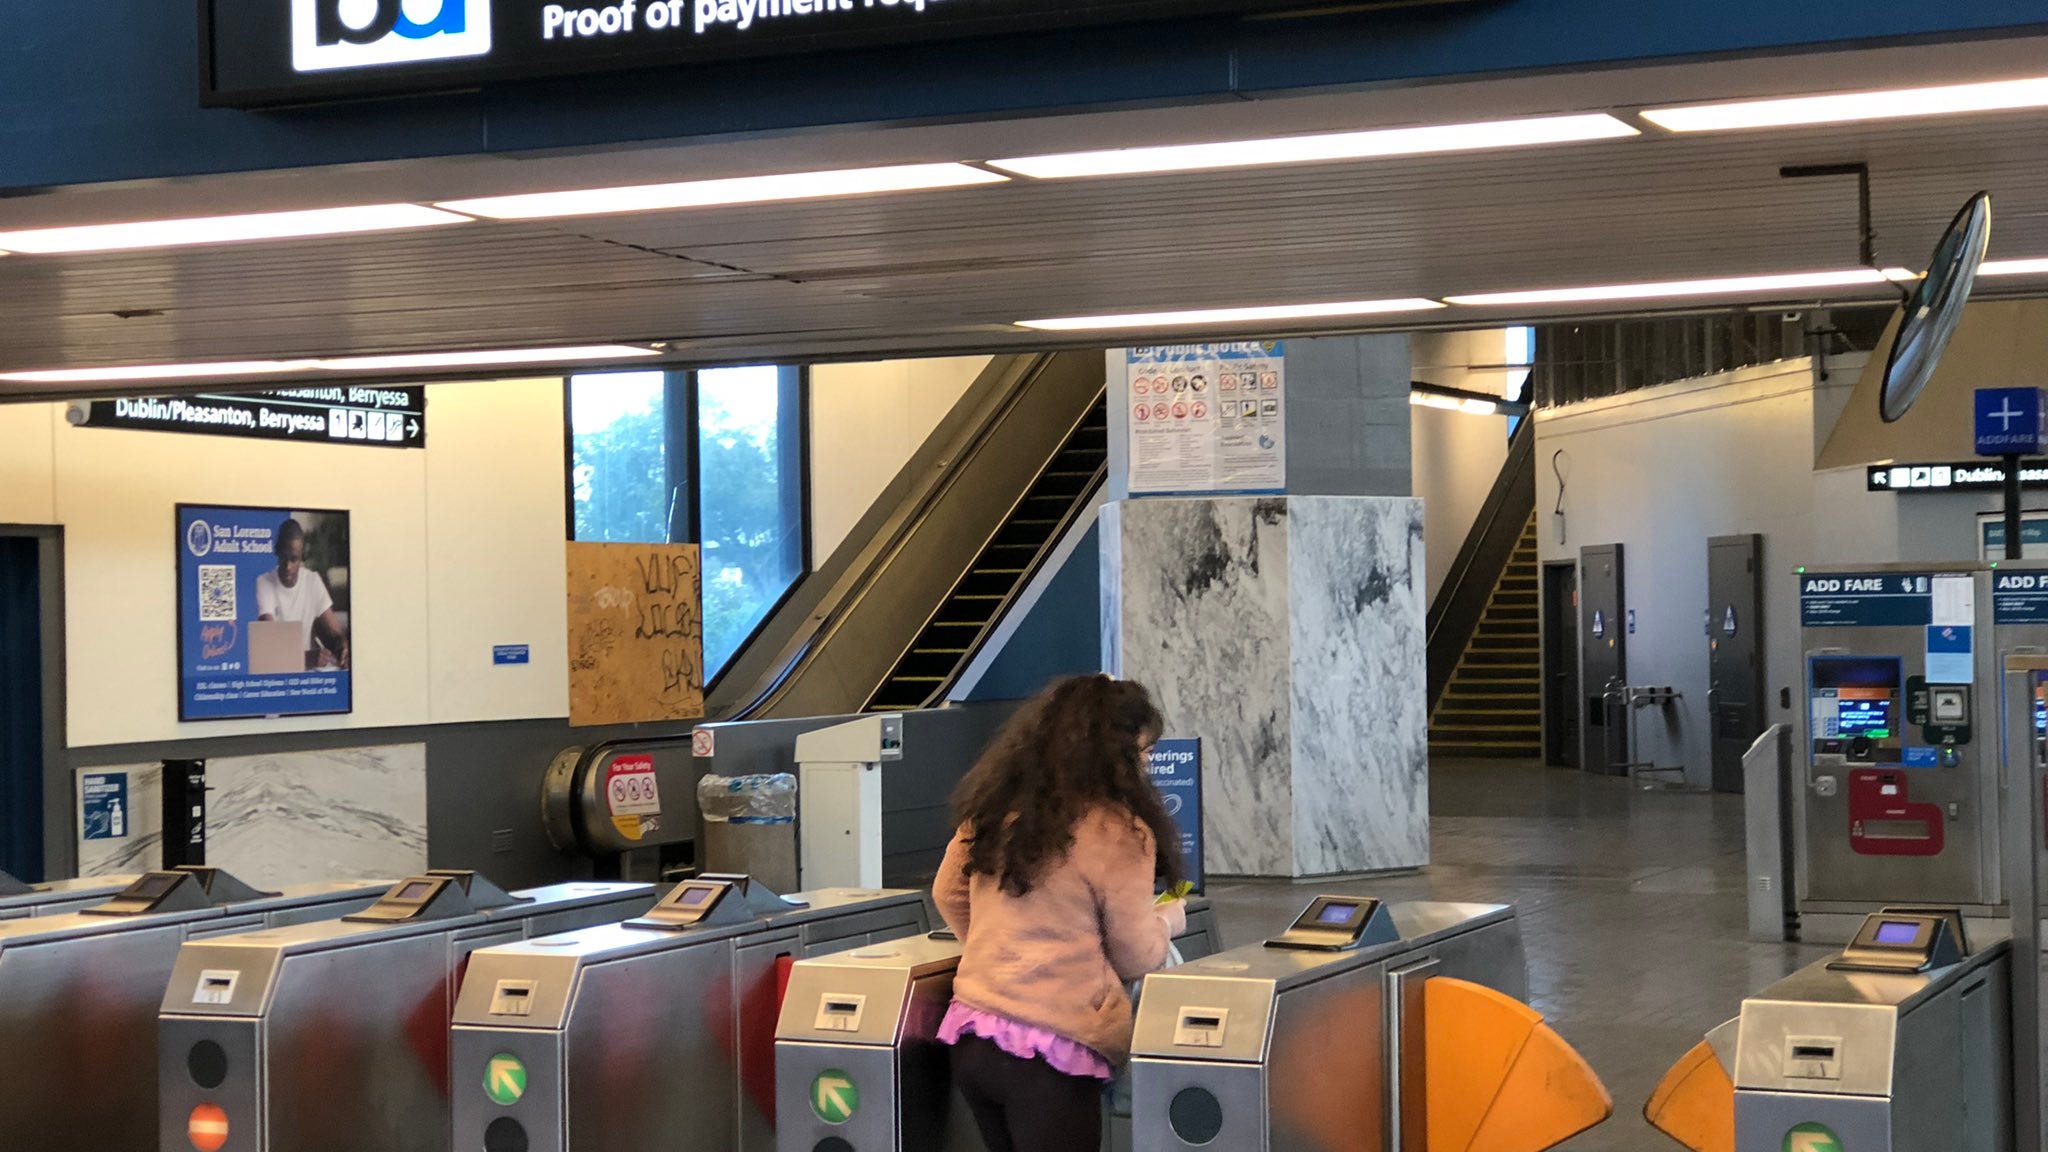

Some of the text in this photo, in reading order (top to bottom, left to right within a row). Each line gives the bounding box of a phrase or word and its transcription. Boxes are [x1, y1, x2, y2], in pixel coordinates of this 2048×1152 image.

[543, 1, 635, 38] Proof
[646, 0, 684, 29] of
[348, 387, 409, 408] Berryessa
[116, 399, 325, 434] Dublin/Pleasanton, Berryessa
[213, 525, 272, 538] San Lorenzo
[213, 540, 273, 553] Adult School
[1805, 578, 1883, 592] ADD FARE
[1999, 576, 2035, 589] ADD
[1148, 750, 1194, 764] verings
[1148, 762, 1175, 774] ired
